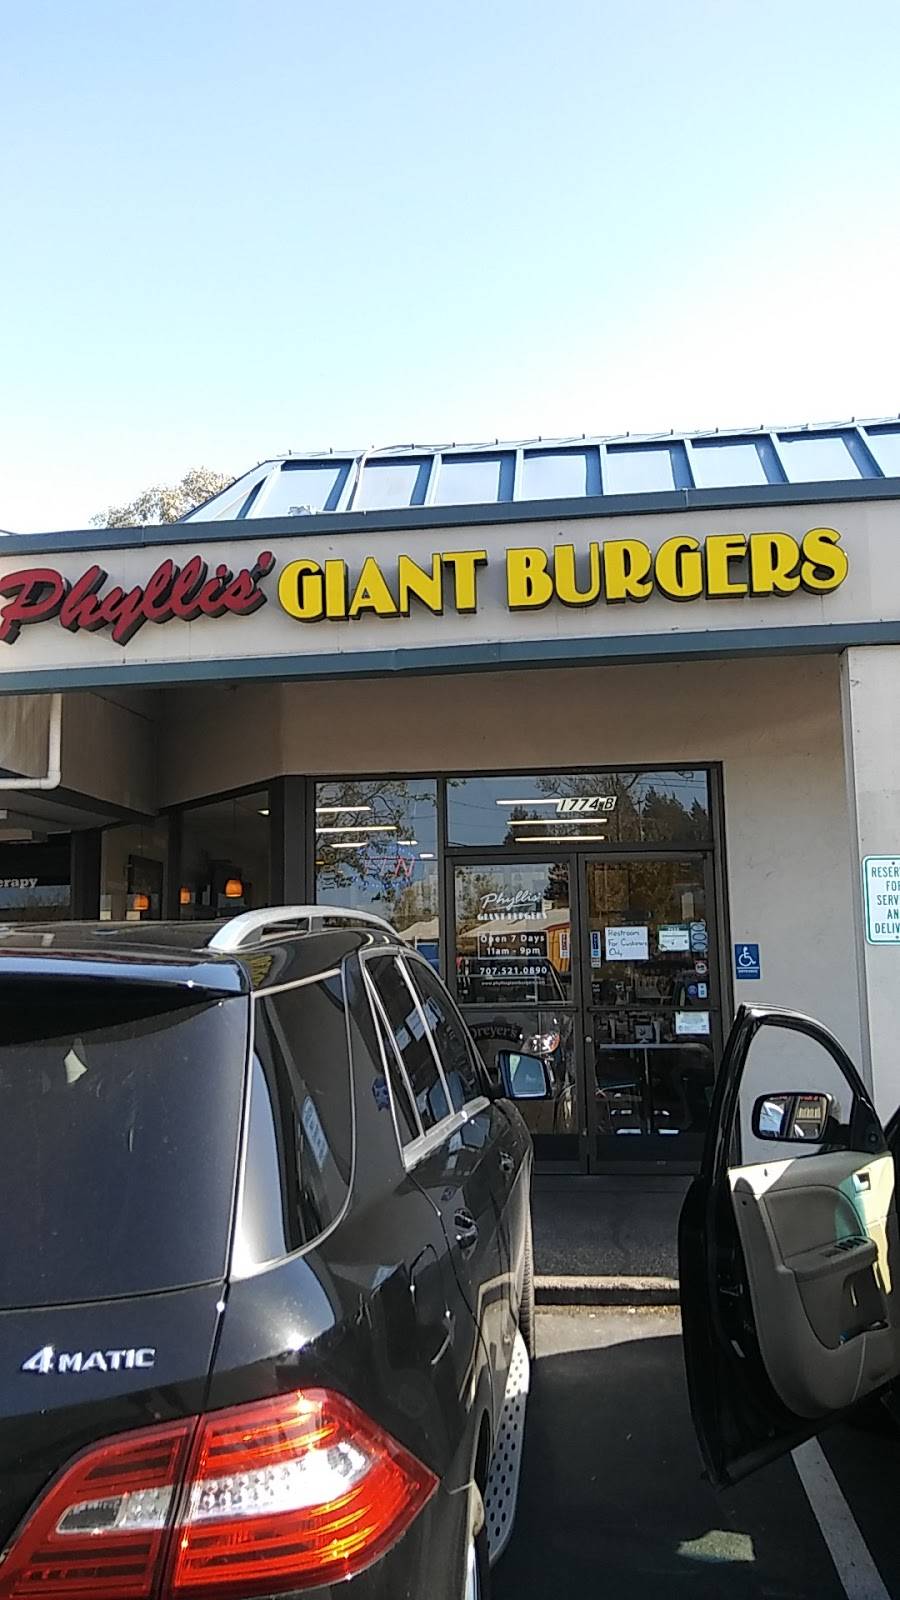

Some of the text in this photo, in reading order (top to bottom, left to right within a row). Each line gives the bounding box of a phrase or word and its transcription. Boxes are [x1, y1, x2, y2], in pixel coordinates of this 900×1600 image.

[278, 550, 487, 623] GIANT
[506, 527, 848, 612] BURGERS
[871, 866, 900, 878] RESER
[481, 934, 545, 947] Open 7 Days
[486, 947, 510, 955] 11am
[519, 946, 541, 955] 9pm
[480, 966, 548, 975] 707.521.0890
